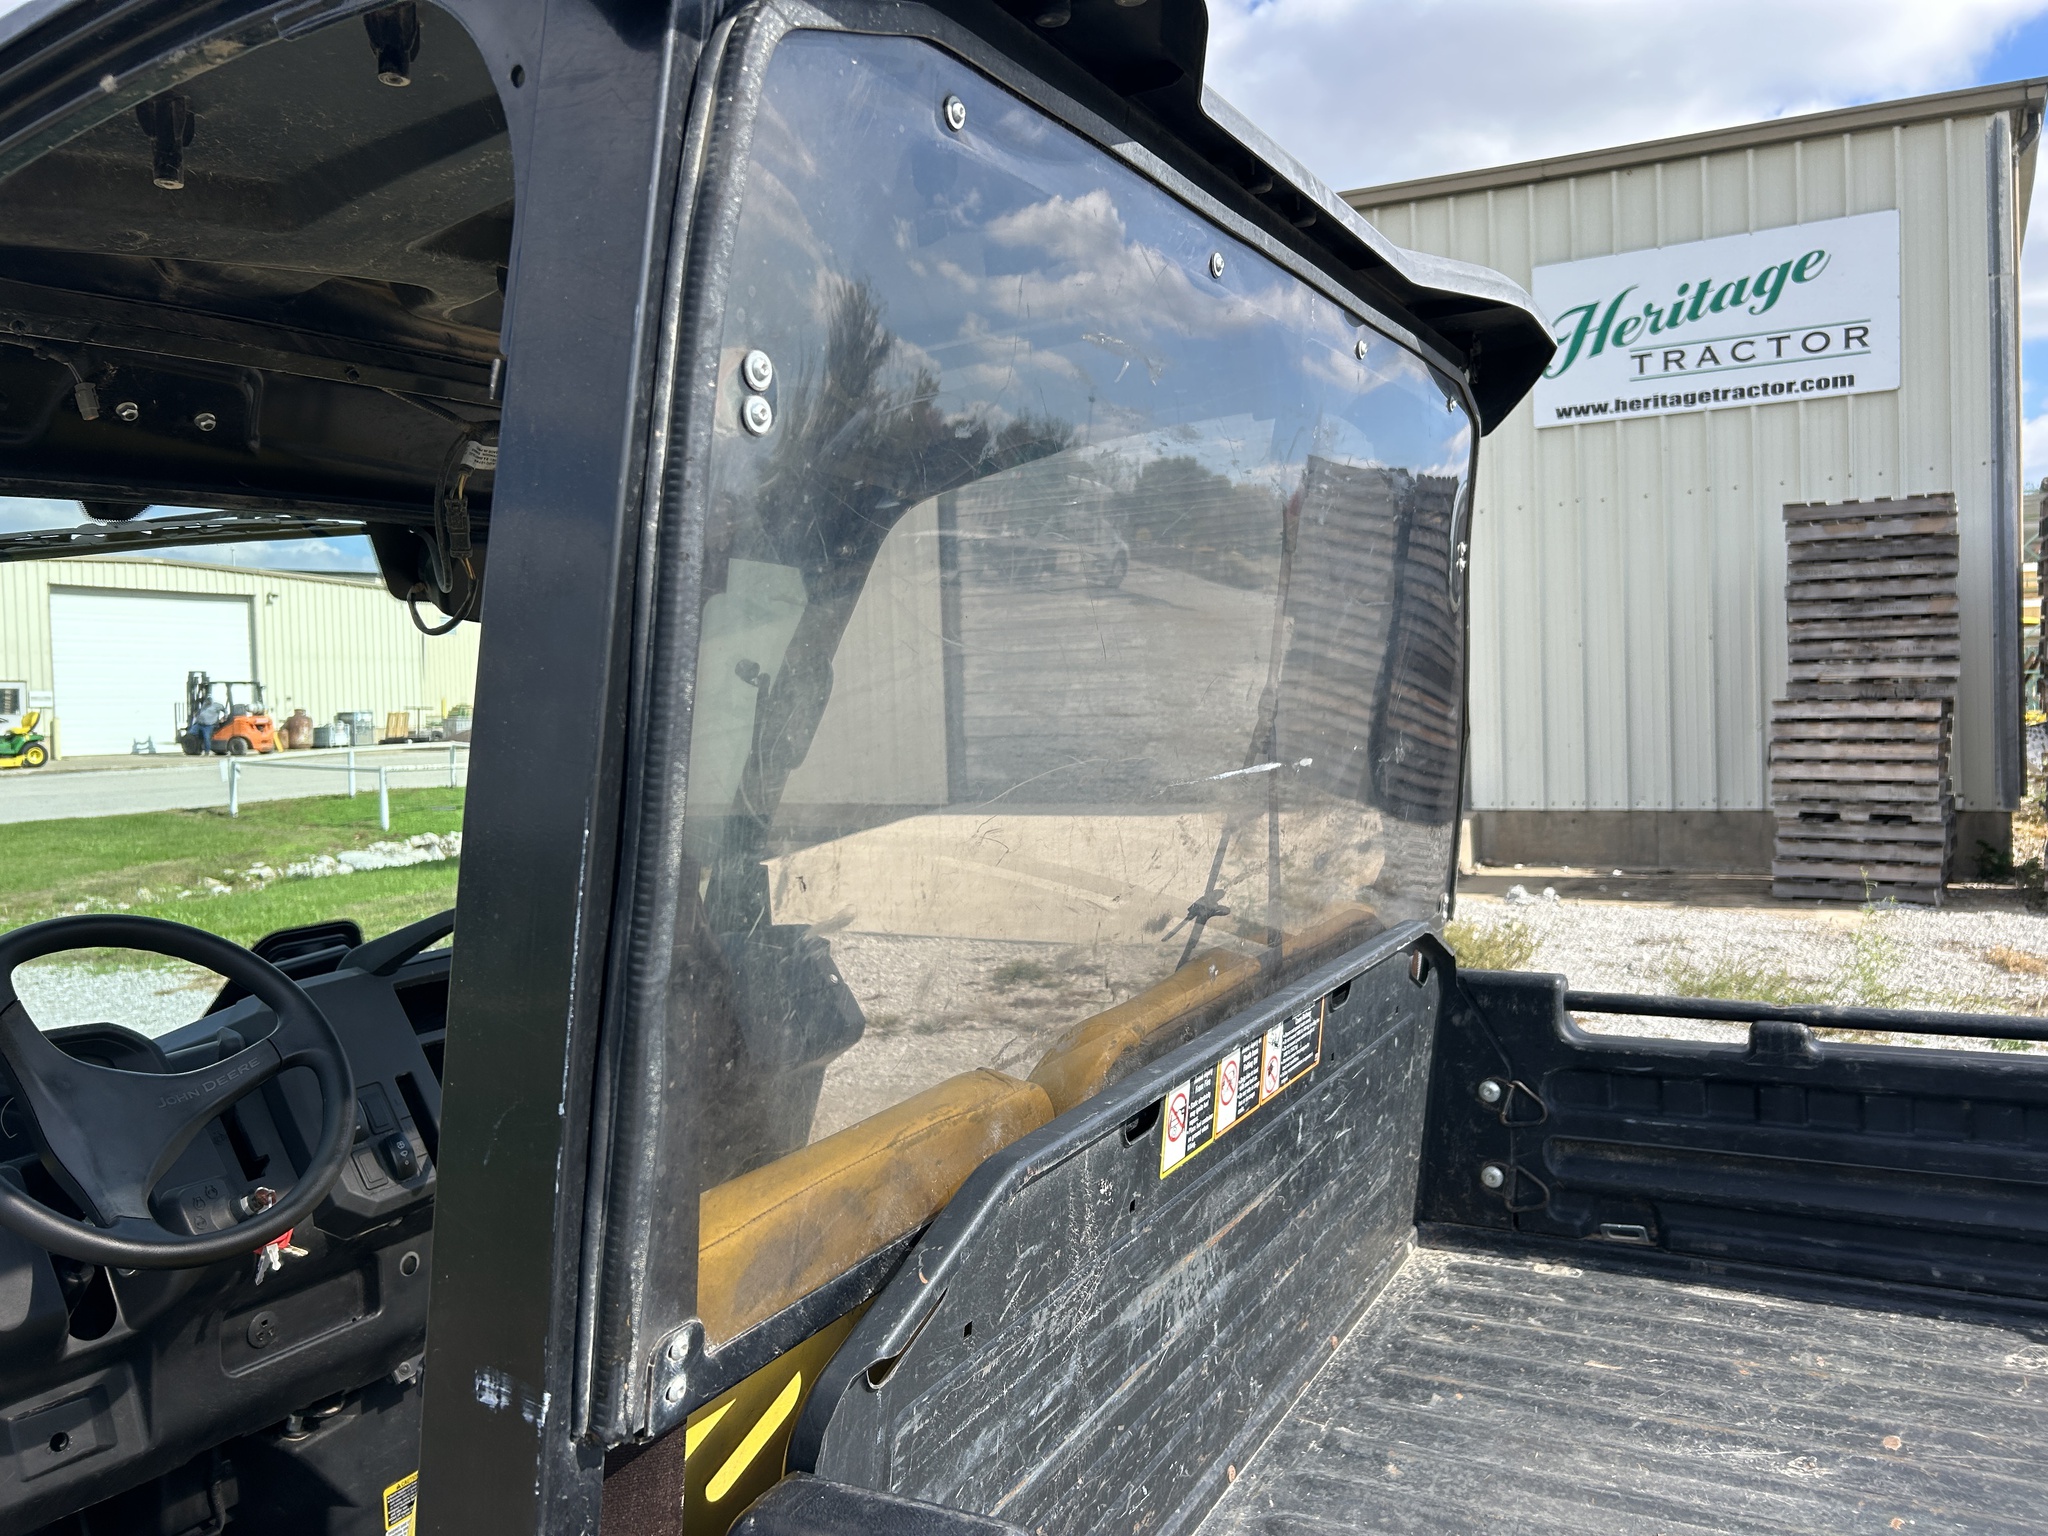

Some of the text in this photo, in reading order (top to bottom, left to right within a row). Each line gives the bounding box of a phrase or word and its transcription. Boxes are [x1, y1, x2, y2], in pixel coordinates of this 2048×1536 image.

[1543, 249, 1832, 379] Heritage
[1629, 325, 1871, 376] TRACTOR
[1555, 373, 1855, 419] www.heritagetractor.com
[159, 1057, 260, 1108] JOHN DEERE
